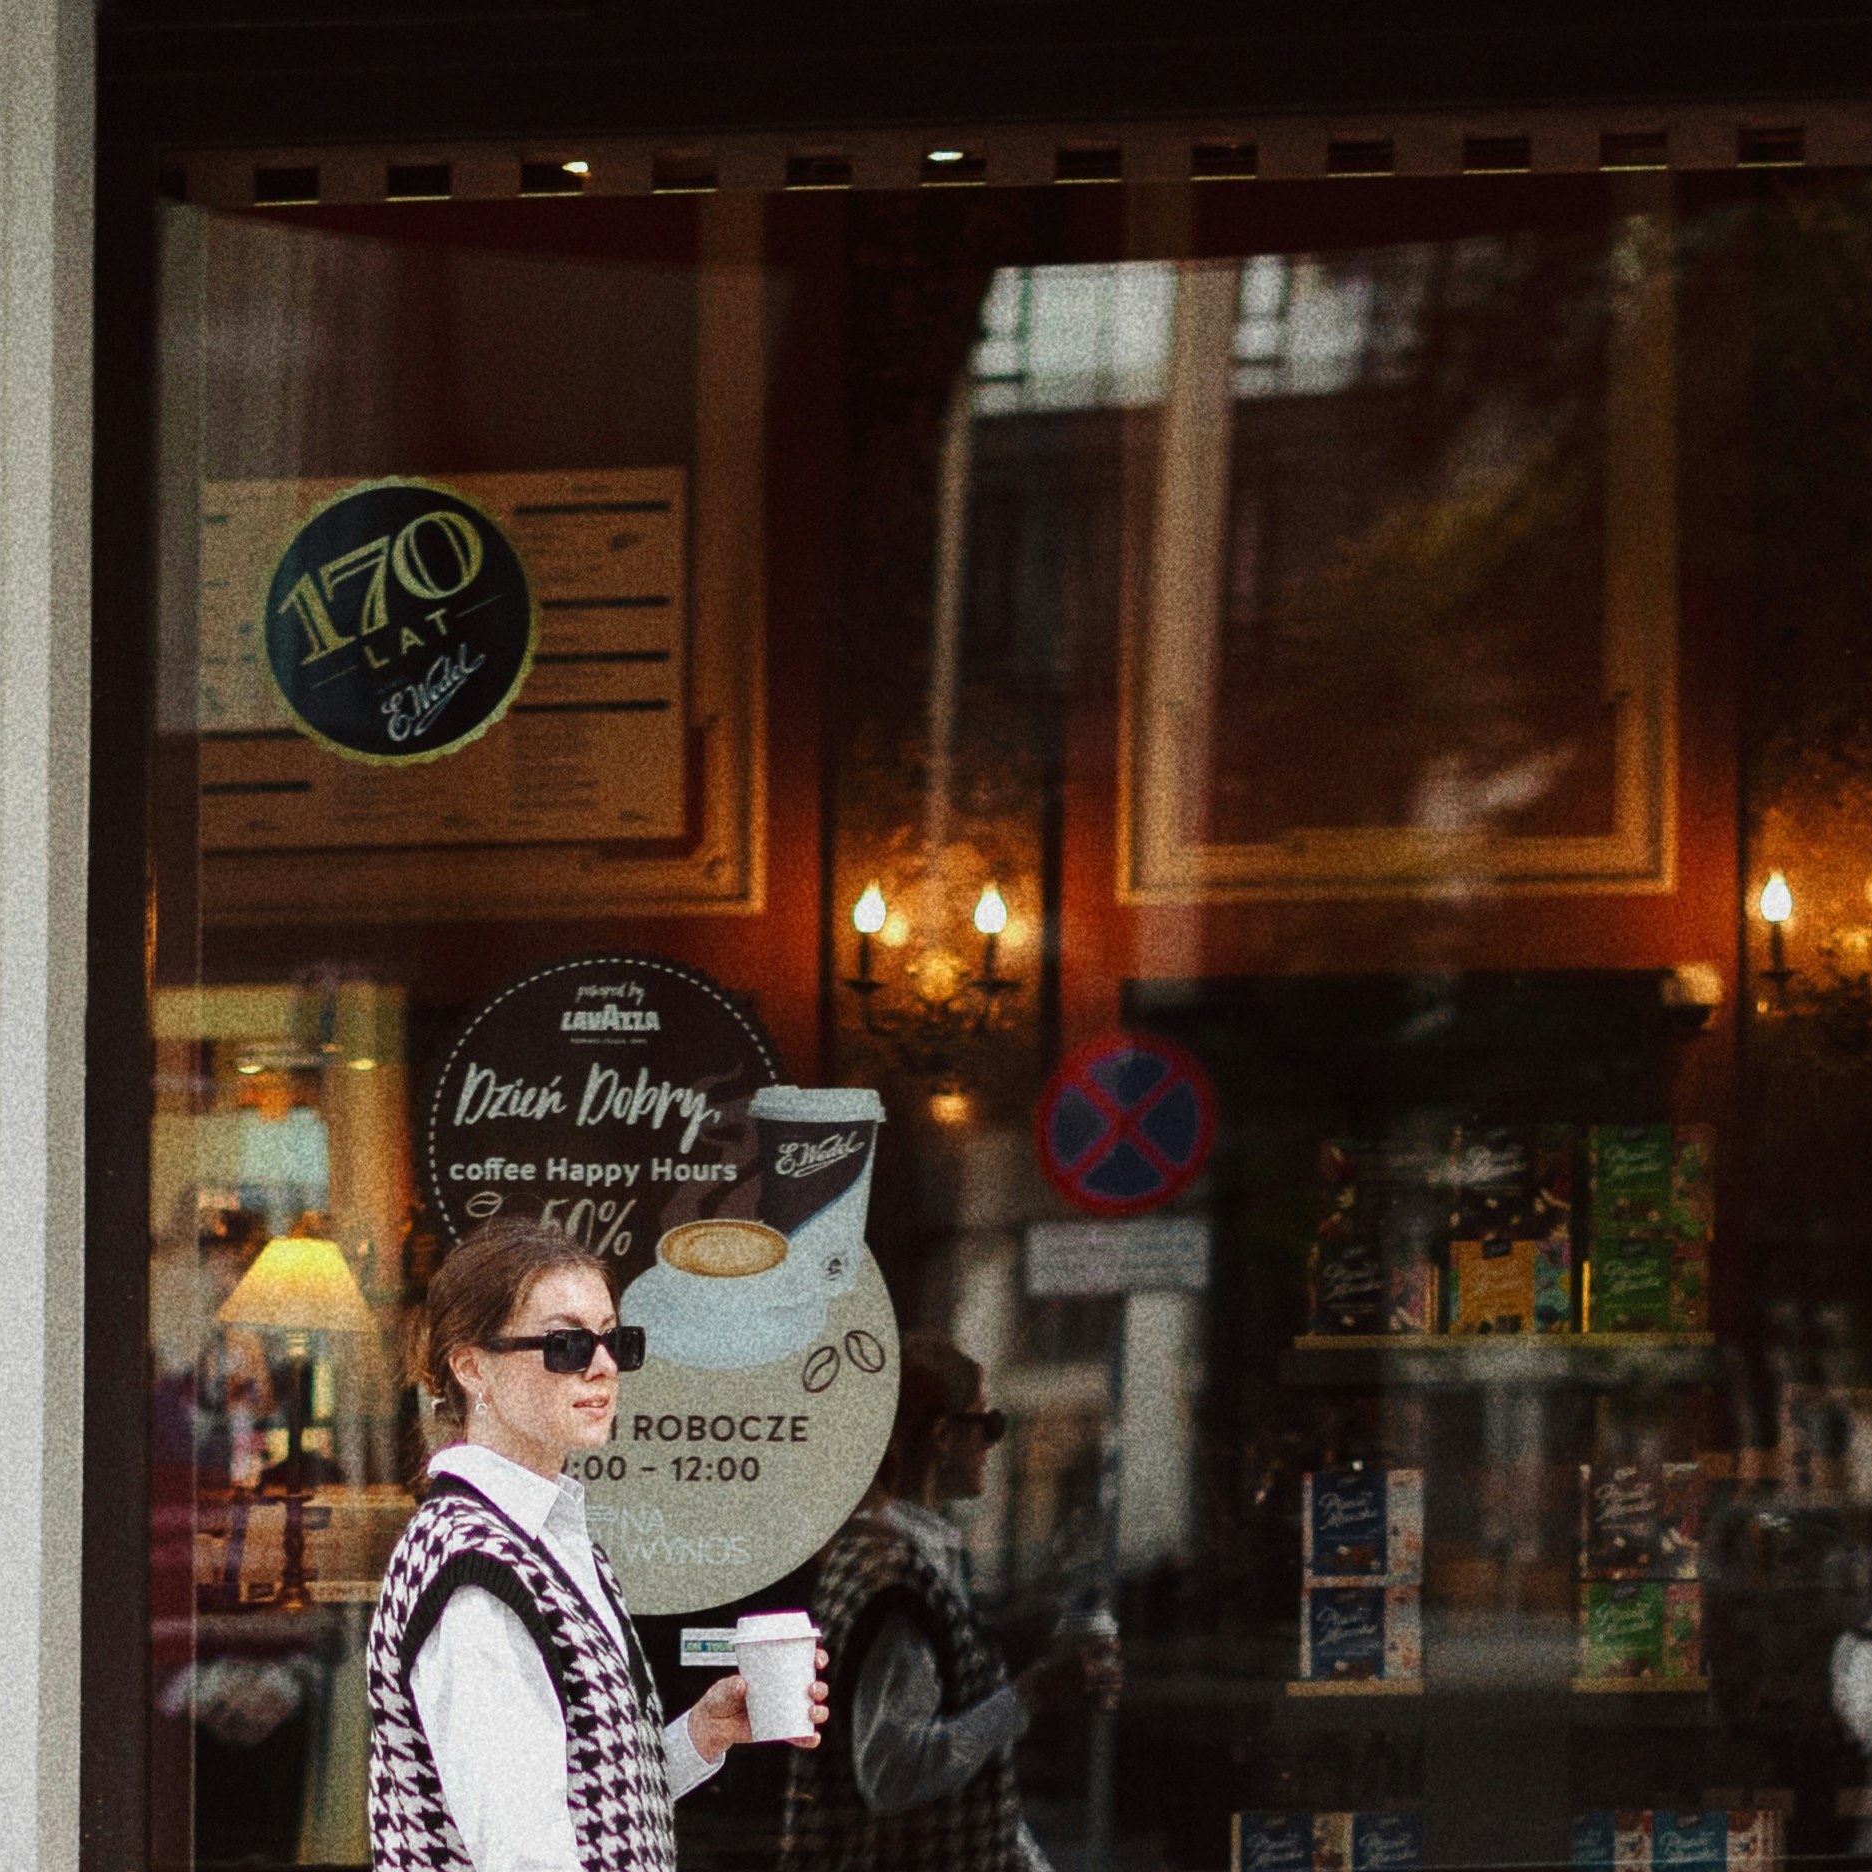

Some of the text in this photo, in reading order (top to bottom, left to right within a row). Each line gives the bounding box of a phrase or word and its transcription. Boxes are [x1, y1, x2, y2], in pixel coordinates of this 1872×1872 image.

[278, 511, 484, 666] 170
[363, 607, 448, 669] LAT
[628, 980, 646, 1006] by
[560, 1003, 662, 1031] LAVAZZA
[453, 1062, 722, 1154] Dzień Dobry,
[449, 1157, 737, 1187] coffee Happy Hours
[633, 1414, 809, 1442] ROBOCZE
[560, 1455, 627, 1481] :00
[671, 1455, 761, 1482] 12:00
[621, 1507, 666, 1533] NA
[622, 1535, 752, 1566] WYNOS
